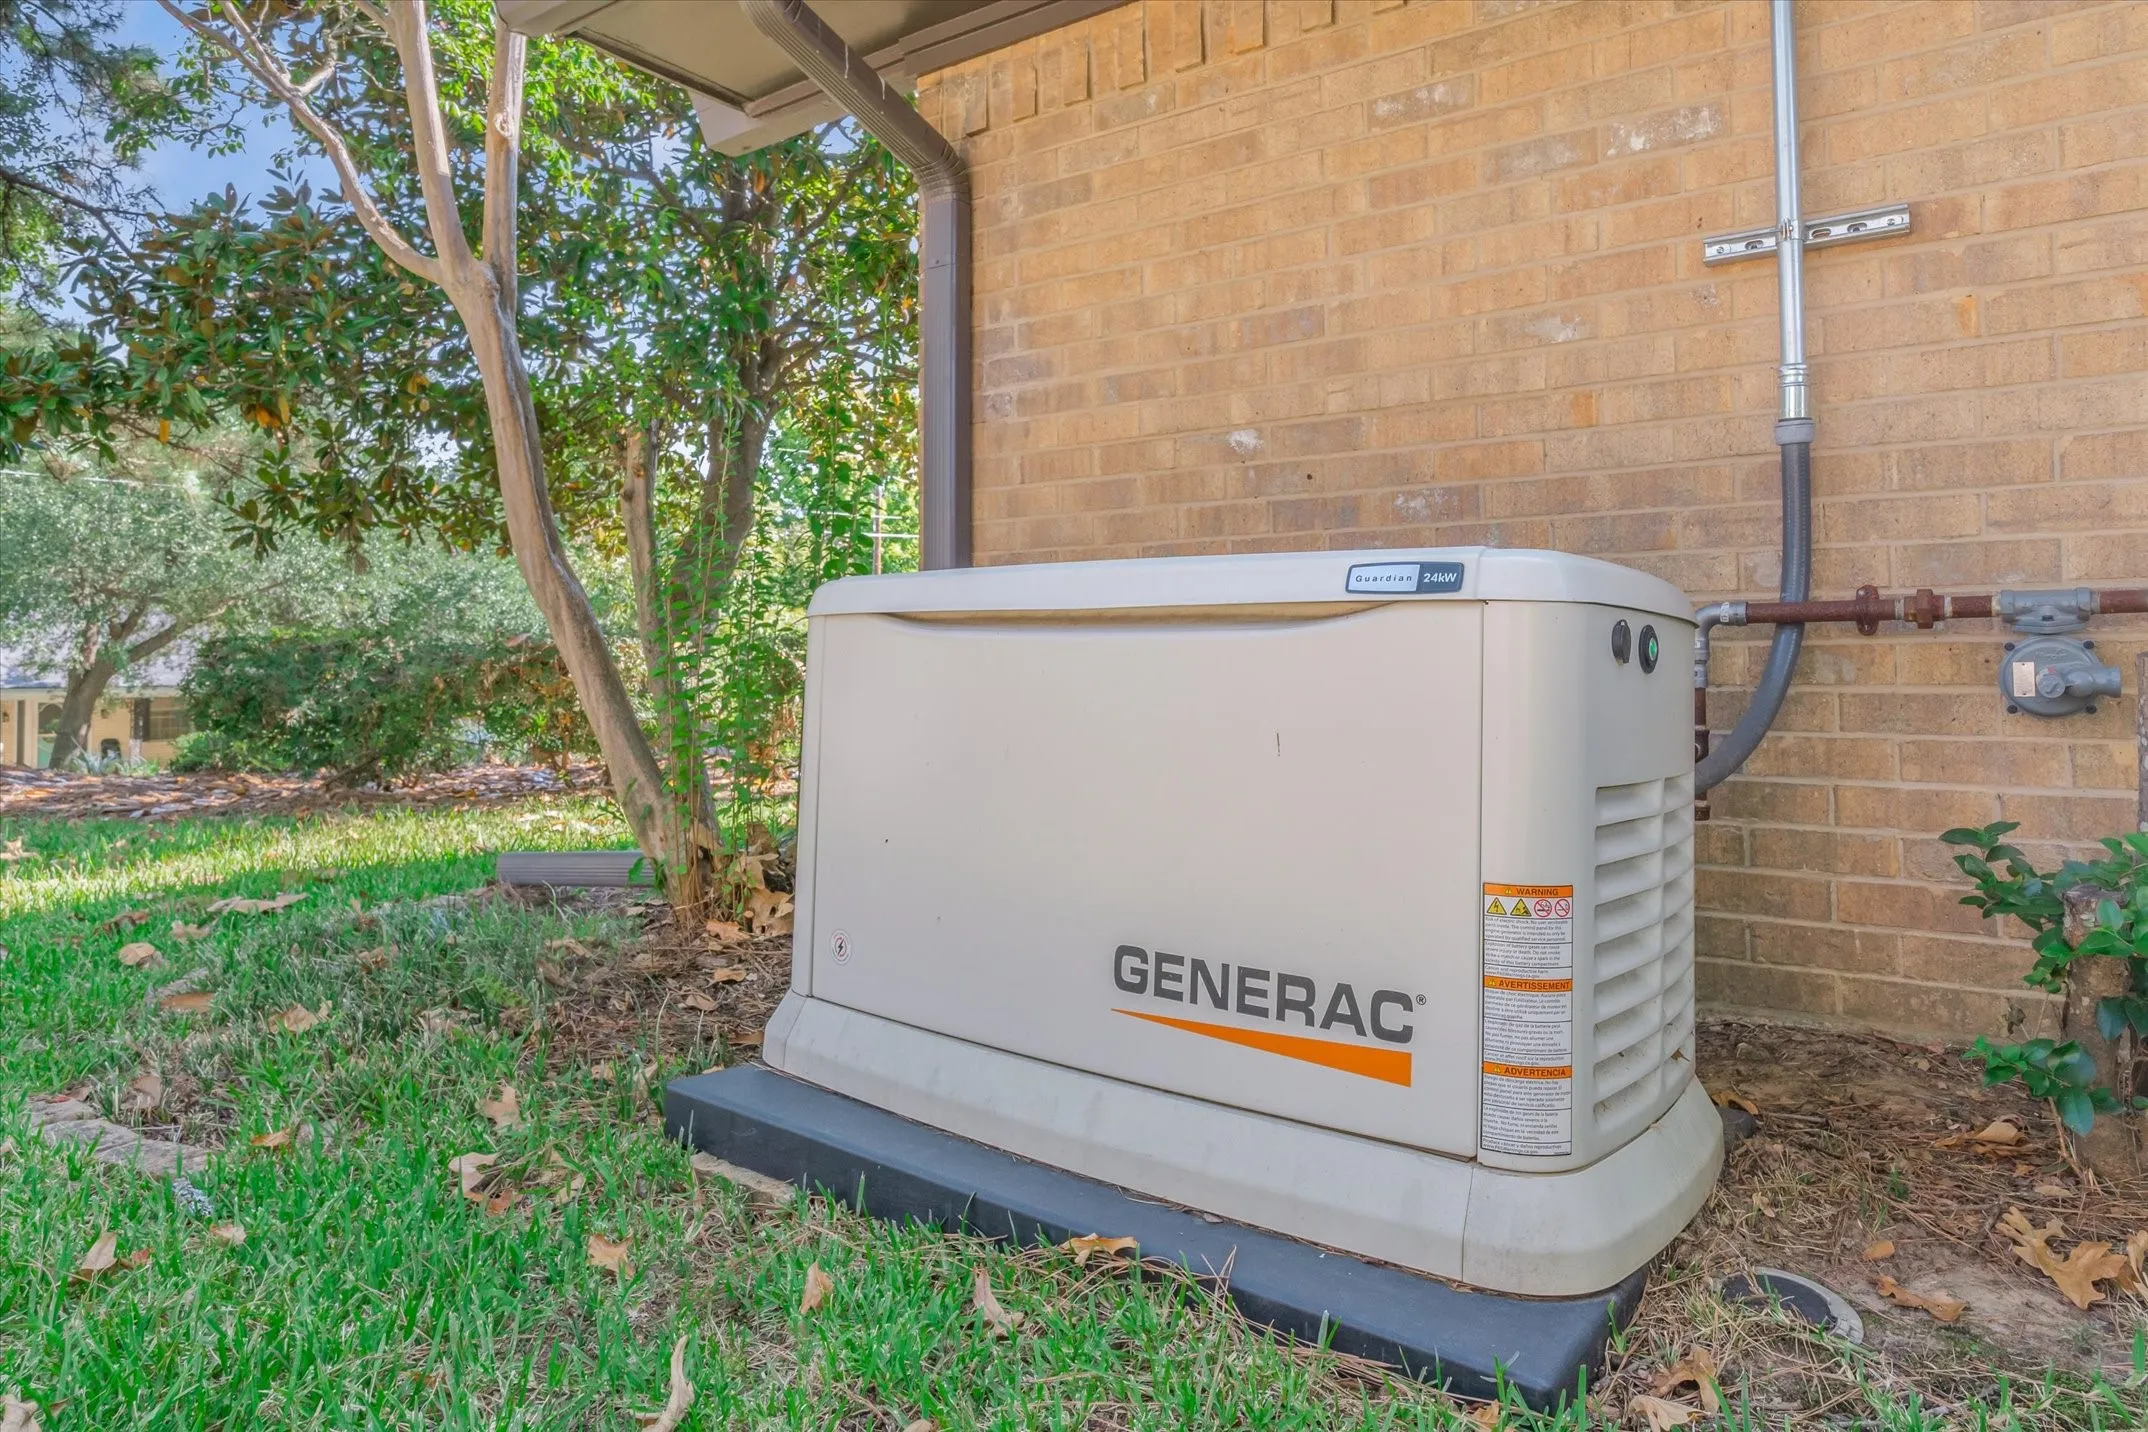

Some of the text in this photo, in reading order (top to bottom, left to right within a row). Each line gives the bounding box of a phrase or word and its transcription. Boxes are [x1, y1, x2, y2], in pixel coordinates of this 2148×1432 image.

[1355, 572, 1457, 583] Guardian 24kW
[1516, 888, 1559, 897] WARNING
[1498, 980, 1570, 990] AVERTISSEMENT
[1504, 1068, 1566, 1077] ADVERTENCIA
